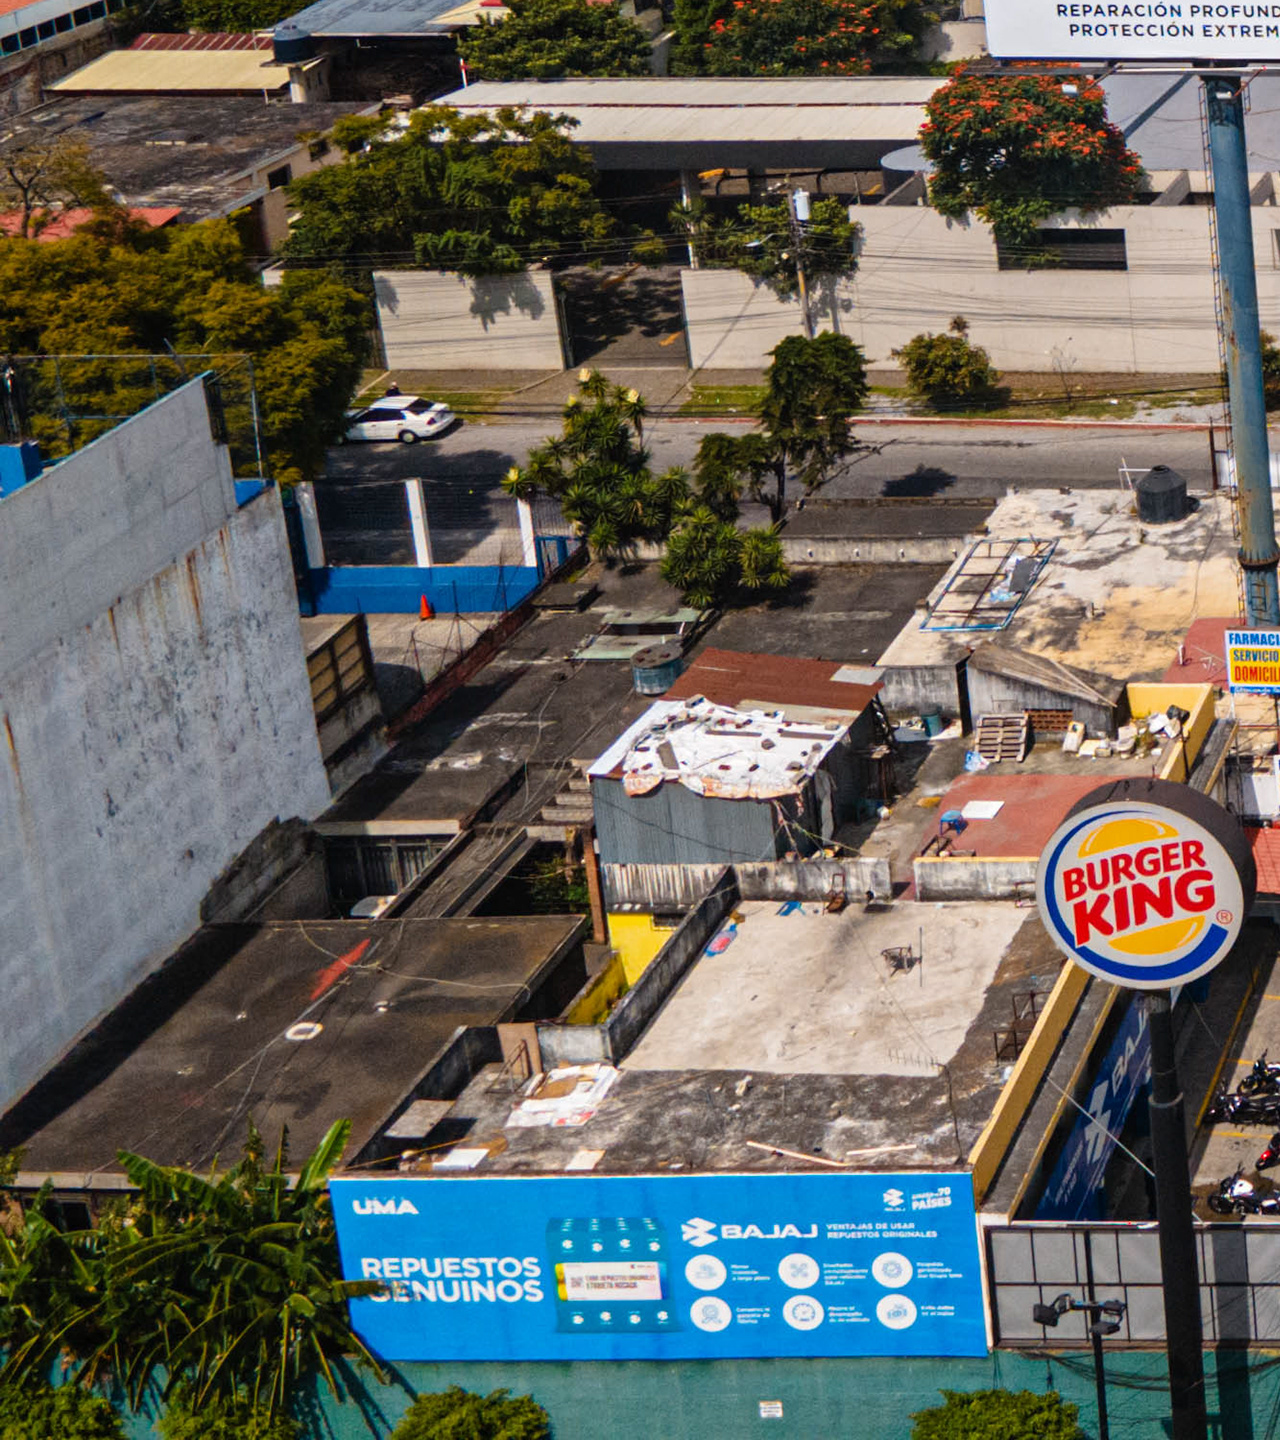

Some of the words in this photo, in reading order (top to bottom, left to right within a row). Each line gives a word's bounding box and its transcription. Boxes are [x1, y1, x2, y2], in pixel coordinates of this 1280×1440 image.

[1057, 1, 1182, 18] REPARACIÓN
[1069, 21, 1194, 38] PROTECCIÓN
[1233, 649, 1279, 662] SERVICIO
[1062, 840, 1207, 902] BURGER
[1072, 870, 1216, 947] KING
[352, 1198, 420, 1215] UMA
[721, 1224, 819, 1239] BAJAJ
[826, 1222, 873, 1231] VENTAJAS
[875, 1222, 888, 1230] DE
[890, 1222, 915, 1230] USAR
[827, 1231, 880, 1240] REPUESTOS
[882, 1231, 938, 1239] ORIGINALES
[361, 1257, 542, 1278] REPUESTOS
